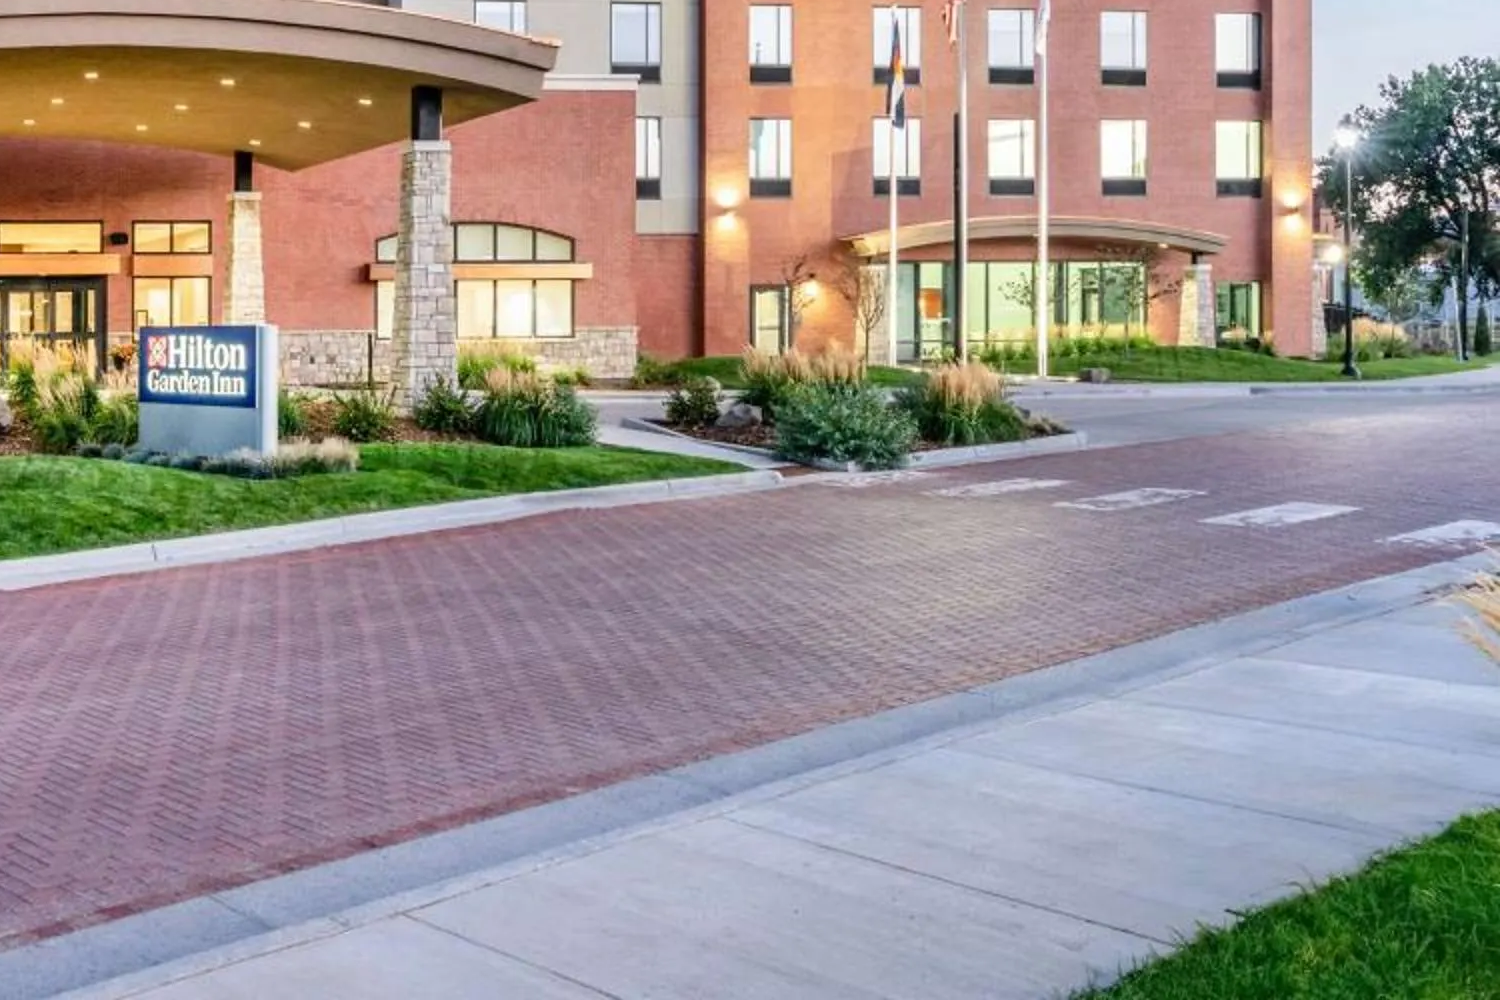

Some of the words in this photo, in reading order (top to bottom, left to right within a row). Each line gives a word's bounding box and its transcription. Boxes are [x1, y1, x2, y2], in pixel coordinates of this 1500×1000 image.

[167, 334, 247, 370] Hilton
[147, 368, 210, 394] Garden
[212, 371, 246, 395] Inn
